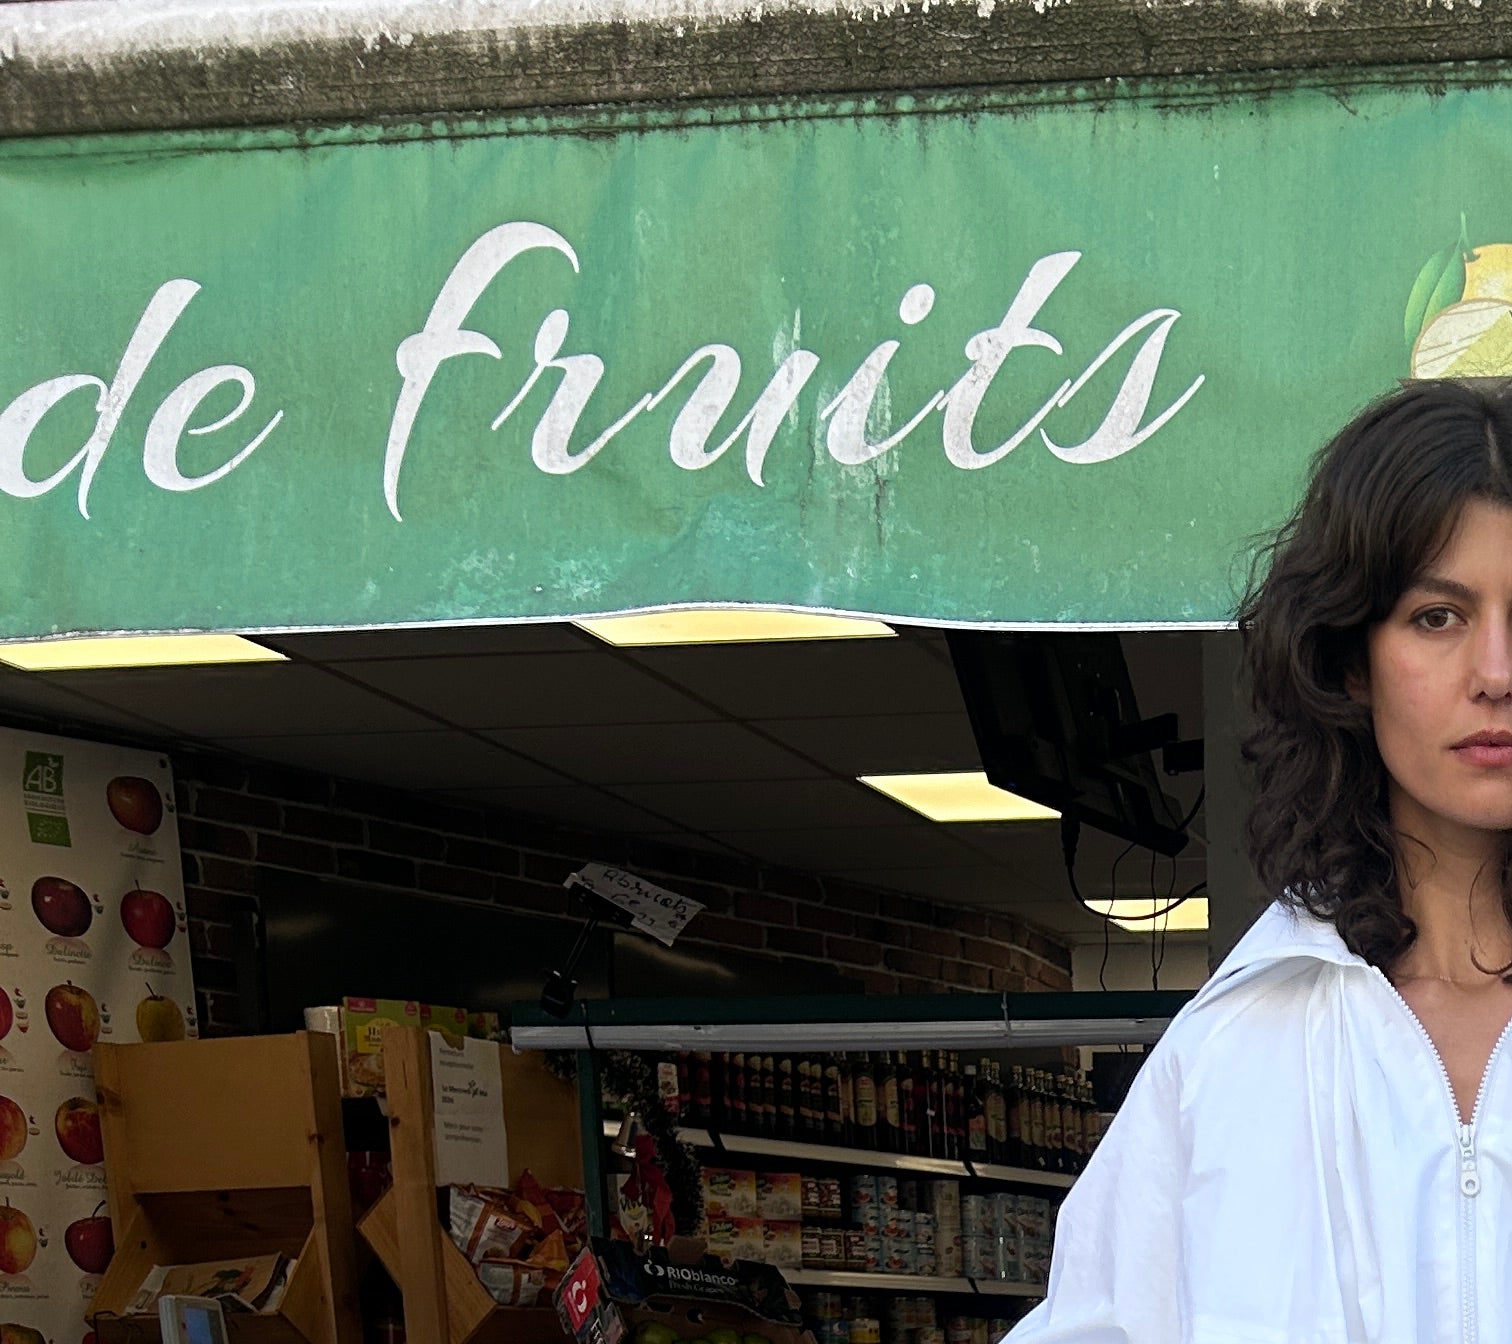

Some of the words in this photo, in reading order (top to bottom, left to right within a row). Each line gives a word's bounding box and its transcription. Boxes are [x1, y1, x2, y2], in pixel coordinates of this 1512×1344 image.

[0, 277, 284, 521] de
[382, 219, 1206, 524] fruits
[666, 1265, 736, 1286] RIOblanco
